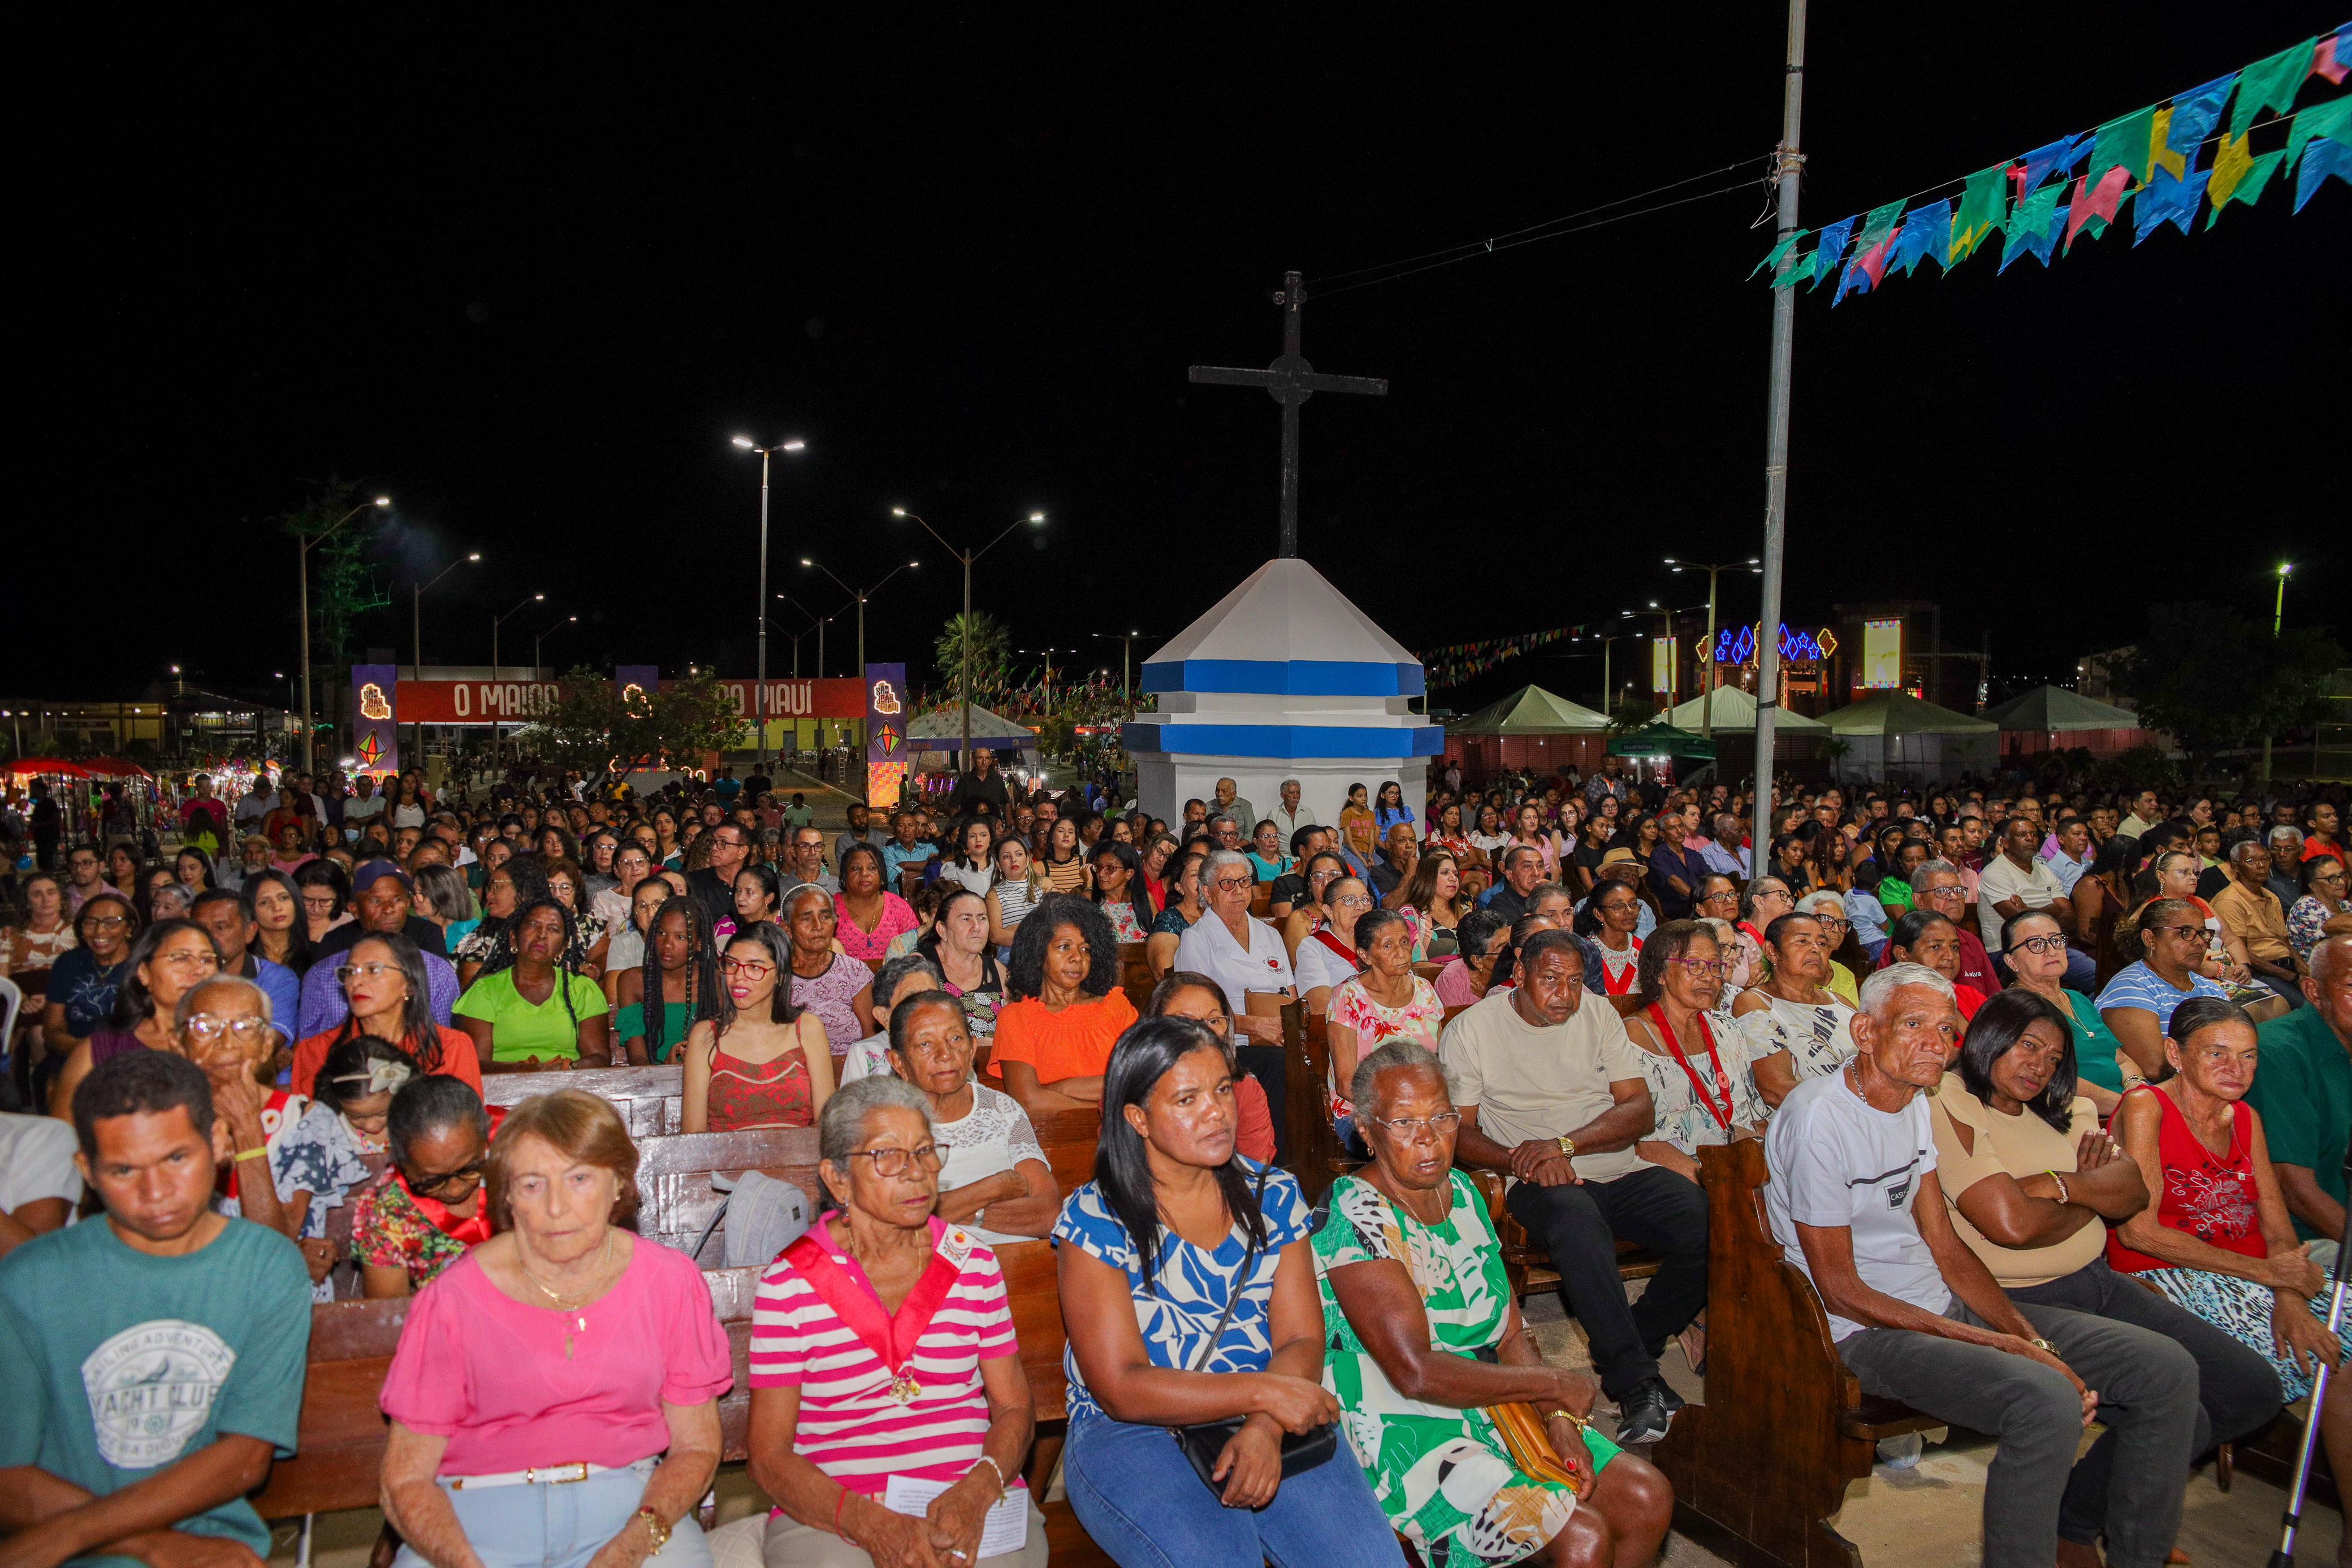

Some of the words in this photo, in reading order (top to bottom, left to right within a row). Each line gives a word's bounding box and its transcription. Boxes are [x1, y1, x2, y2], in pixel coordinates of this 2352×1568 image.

[454, 684, 470, 717] O
[755, 680, 812, 715] PIAUÍ
[90, 1387, 158, 1415] YACHT
